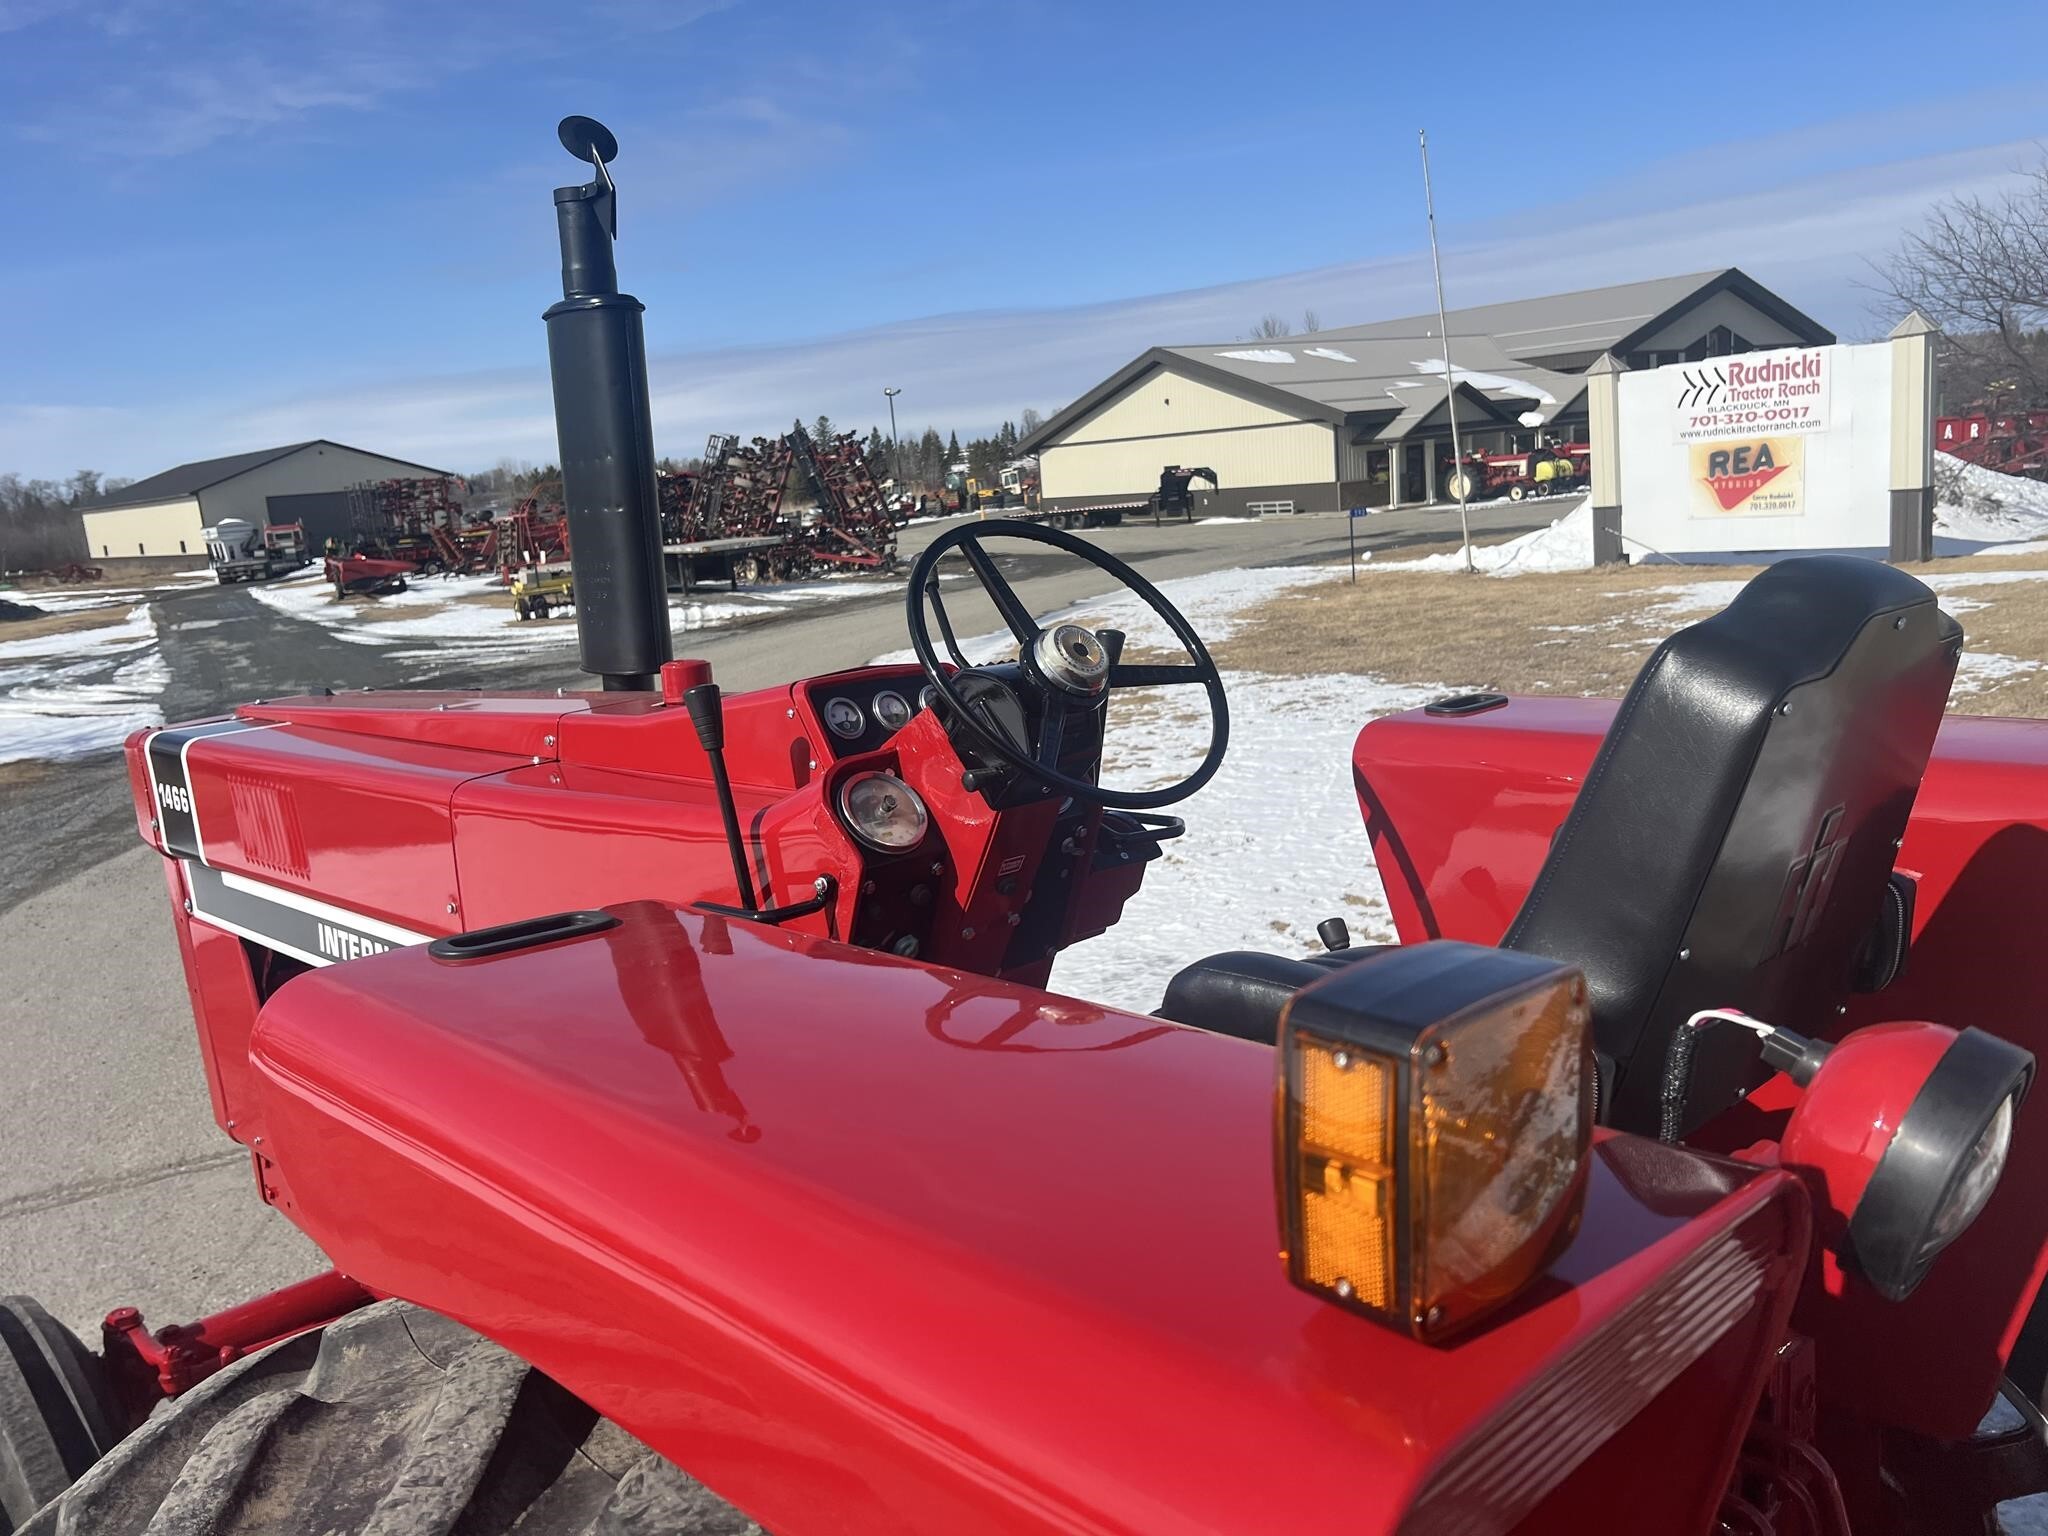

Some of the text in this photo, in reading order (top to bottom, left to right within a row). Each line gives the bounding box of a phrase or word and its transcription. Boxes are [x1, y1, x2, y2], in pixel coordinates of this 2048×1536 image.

[1728, 352, 1821, 387] Rudnicki
[1728, 380, 1820, 402] Tractor Ranch
[1690, 406, 1810, 428] 701-320-0017
[1707, 401, 1771, 414] BLACKDUCK,
[1679, 419, 1821, 438] www.rudnickitractorranch.com
[1709, 443, 1775, 478] REA
[158, 782, 189, 813] 1466
